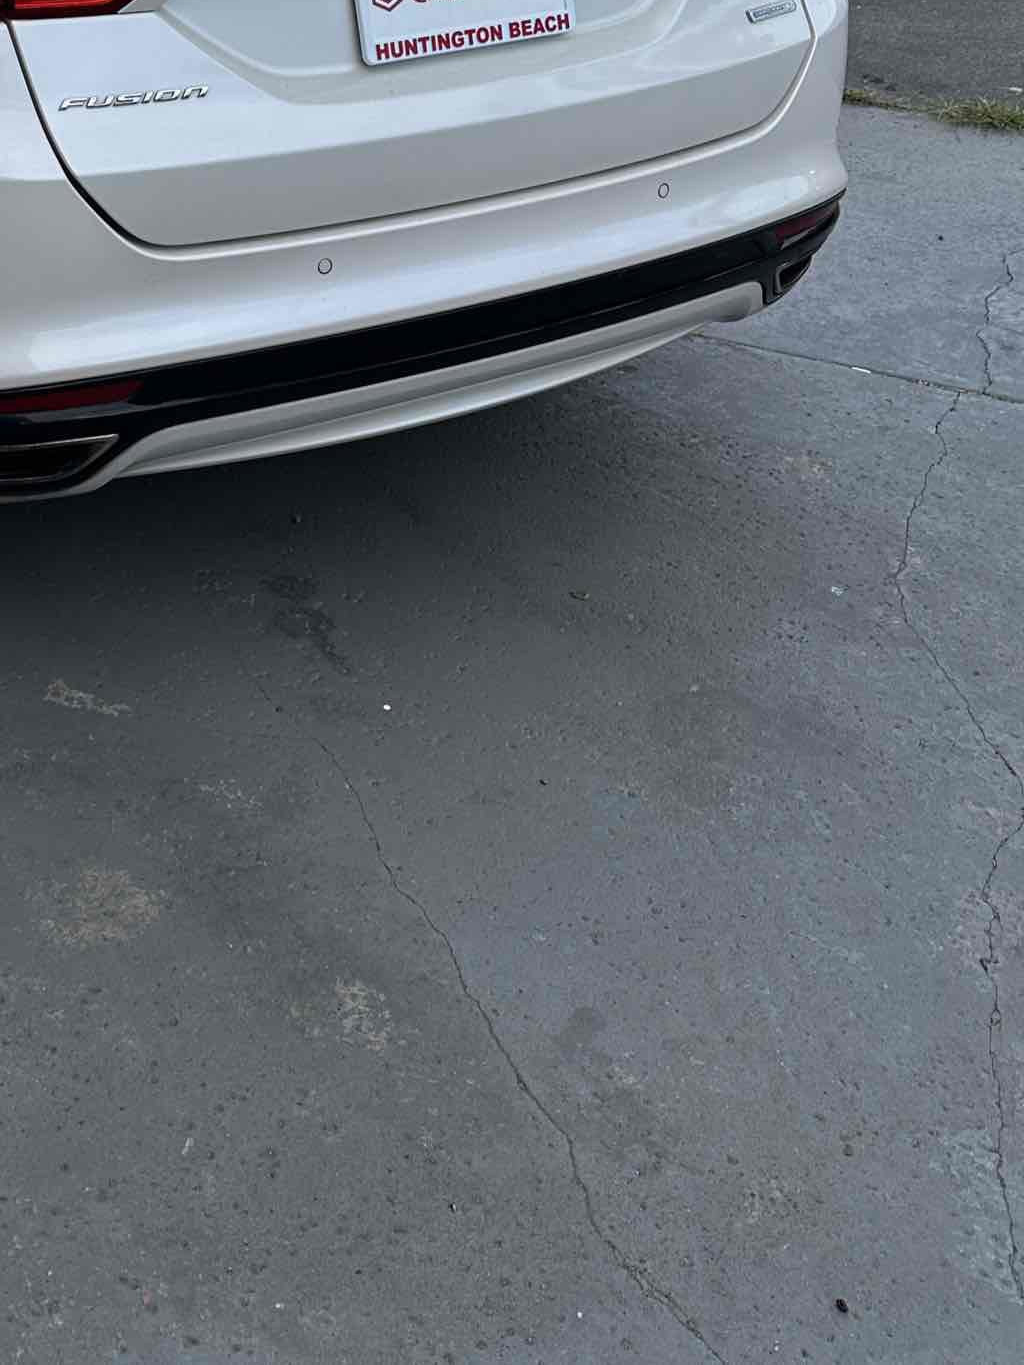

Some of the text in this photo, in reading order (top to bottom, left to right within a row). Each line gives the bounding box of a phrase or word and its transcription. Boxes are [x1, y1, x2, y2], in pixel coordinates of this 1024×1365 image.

[375, 13, 570, 60] HUNTINGTON BEACH
[58, 83, 209, 111] FUSION
